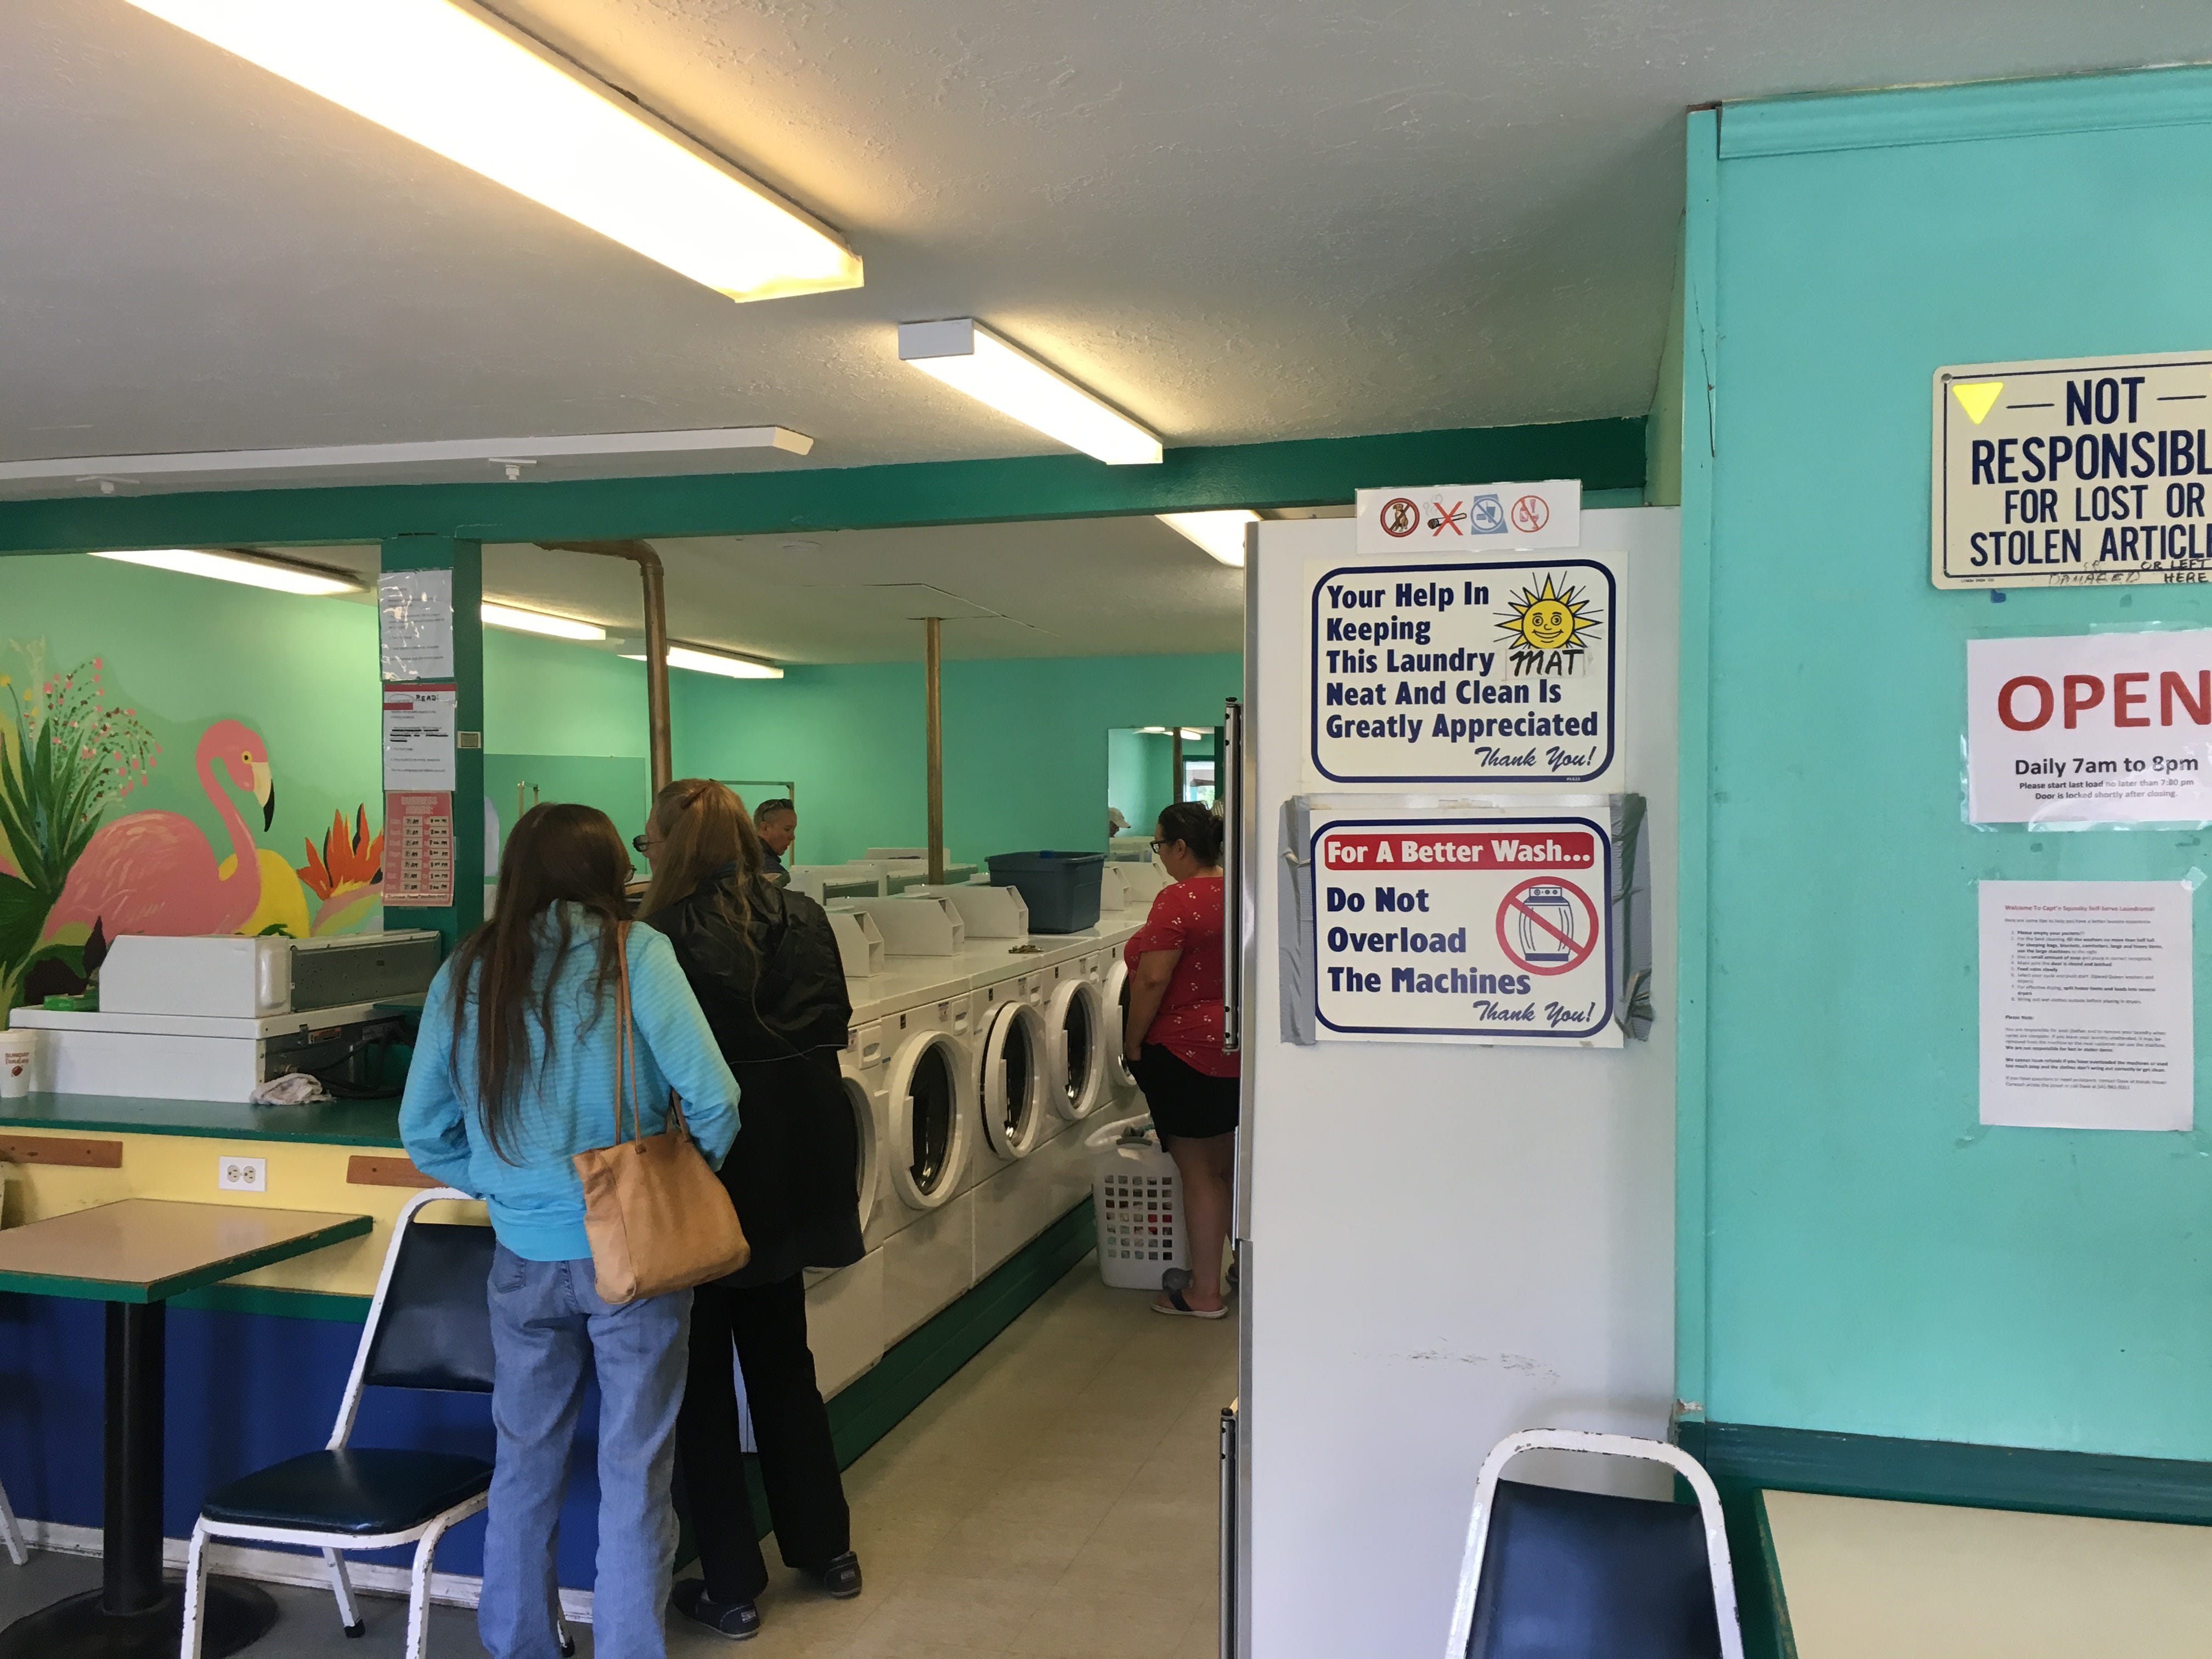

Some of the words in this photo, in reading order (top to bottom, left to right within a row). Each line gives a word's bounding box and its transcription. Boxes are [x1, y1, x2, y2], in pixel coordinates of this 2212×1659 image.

[2066, 376, 2146, 426] NOT
[2005, 488, 2058, 524] FOR
[2075, 485, 2148, 521] LOST
[2166, 482, 2205, 517] OR
[1970, 528, 2081, 567] STOLEN
[2141, 561, 2163, 570] OR
[2170, 558, 2211, 569] LEFT
[2164, 572, 2209, 583] HERE
[1327, 585, 1386, 609] Your
[1396, 583, 1454, 612] Help
[1464, 581, 1490, 605] In
[1326, 616, 1431, 646] Keeping
[1326, 649, 1378, 674] This
[1386, 648, 1496, 676] Laundry
[1510, 648, 1583, 676] MAT
[1326, 682, 1386, 706] Neat
[1396, 681, 1446, 705] And
[1455, 680, 1529, 704] Clean
[1539, 679, 1561, 703] Is
[1997, 670, 2211, 731] OPEN
[1326, 714, 1422, 743] Greatly
[1431, 711, 1598, 743] Appreciated
[1475, 746, 1536, 767] Thank
[1545, 745, 1595, 772] You!
[2015, 758, 2066, 777] Daily
[2073, 758, 2117, 774] 7am
[2124, 758, 2146, 772] to
[2152, 755, 2198, 775] 8pm
[2094, 791, 2123, 799] shortly
[2147, 790, 2179, 799] closing.
[1328, 841, 1368, 864] For
[1376, 841, 1394, 863] A
[1402, 840, 1483, 862] Better
[1491, 839, 1590, 862] Wash...
[1327, 887, 1364, 912] Do
[1375, 887, 1429, 912] Not
[1327, 927, 1466, 953] Overload
[1327, 967, 1381, 992] The
[1392, 967, 1531, 994] Machines
[1473, 1001, 1534, 1022] Thank
[1544, 1002, 1594, 1028] You!
